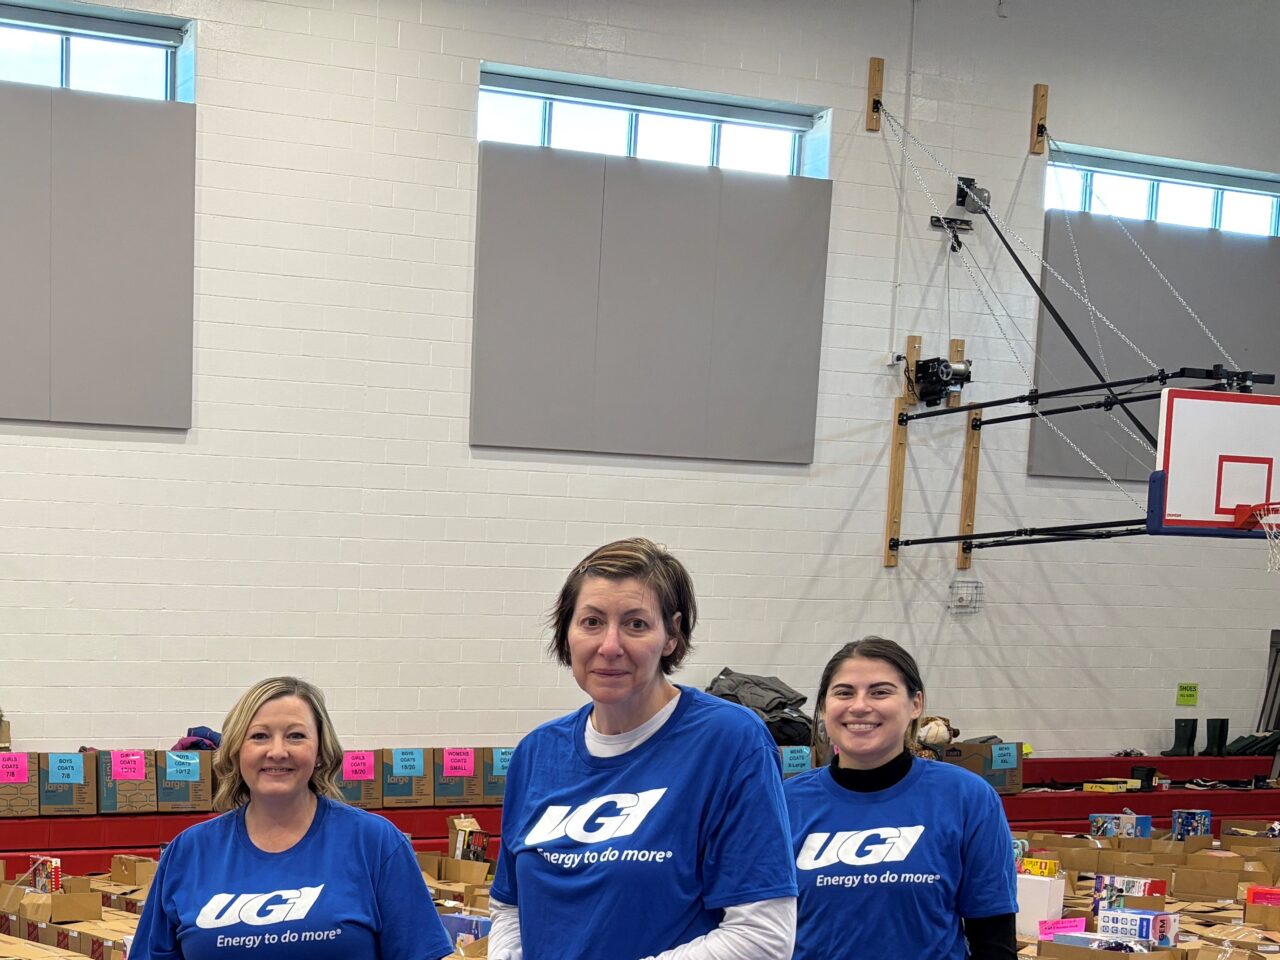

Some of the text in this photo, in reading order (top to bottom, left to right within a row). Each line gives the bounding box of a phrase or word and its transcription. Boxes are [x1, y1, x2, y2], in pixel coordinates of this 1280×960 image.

[584, 851, 598, 864] to
[600, 847, 619, 862] do
[796, 825, 925, 870] UGI
[816, 874, 861, 888] Energy
[863, 873, 877, 884] to
[880, 870, 898, 883] do
[195, 883, 325, 929] UGI
[217, 935, 262, 948] Energy
[264, 933, 278, 944] to
[281, 930, 299, 943] do
